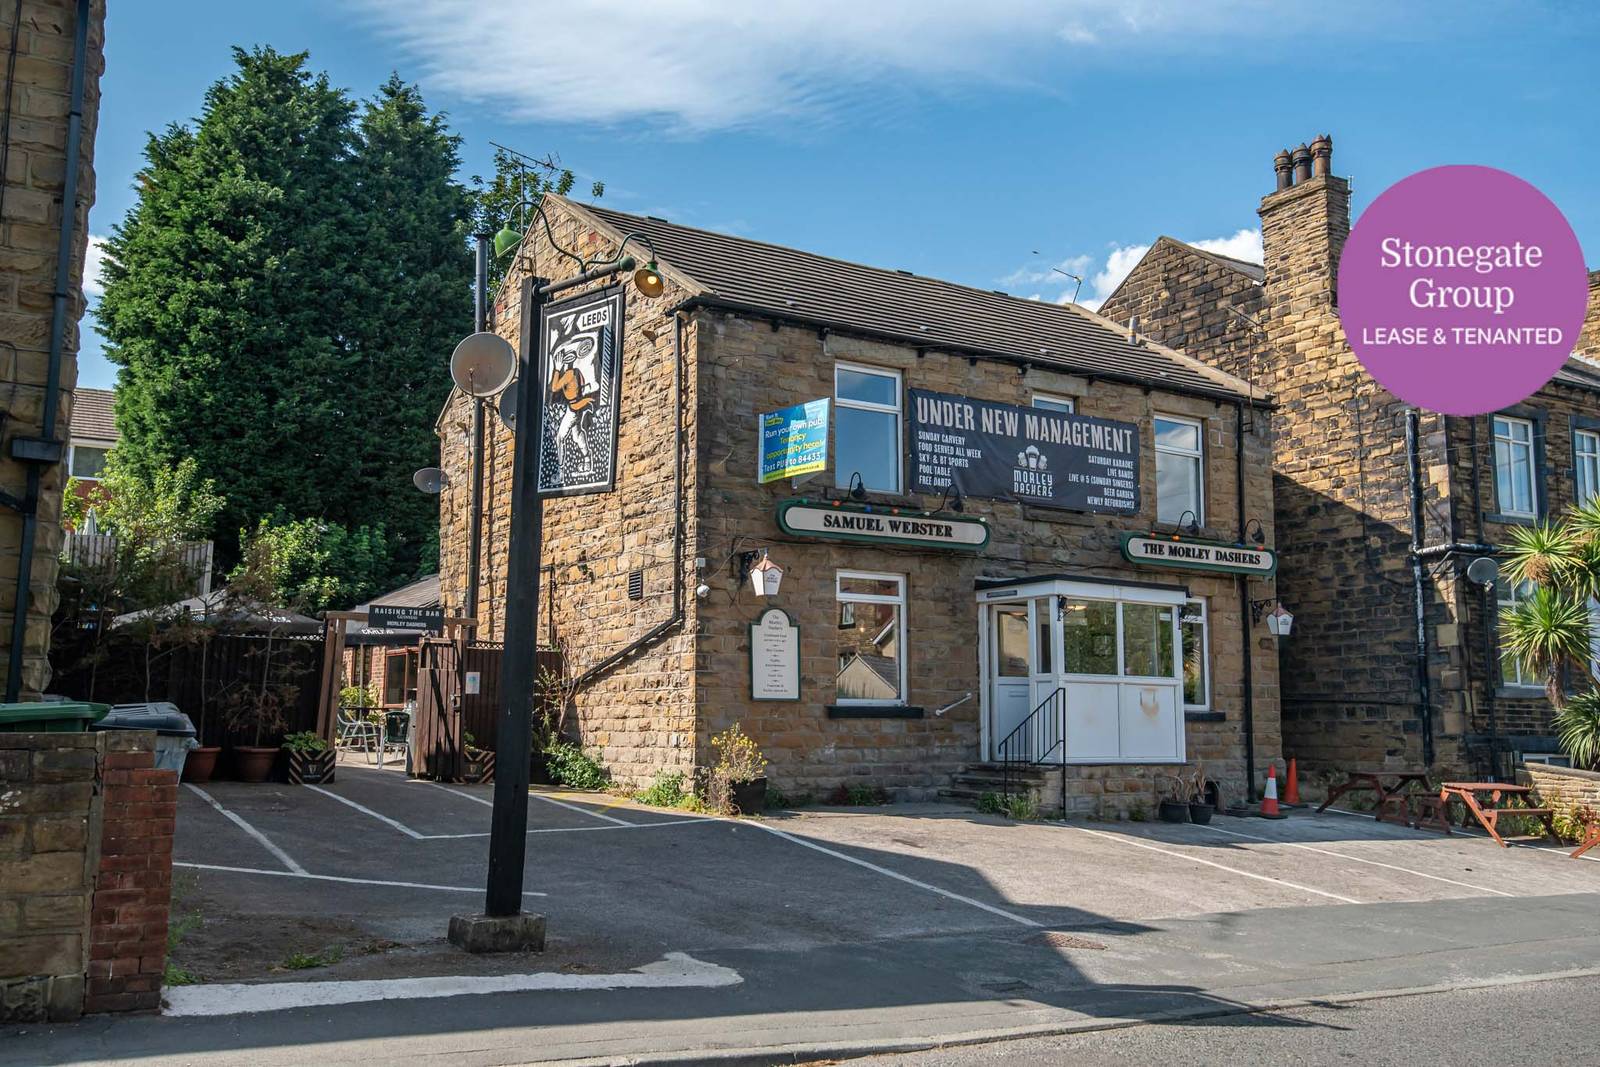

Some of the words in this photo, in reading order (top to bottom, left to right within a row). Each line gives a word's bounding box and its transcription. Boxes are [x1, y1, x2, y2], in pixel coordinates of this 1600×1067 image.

[582, 310, 607, 327] LEEDS
[765, 430, 777, 438] Run
[792, 421, 807, 430] own
[917, 397, 975, 431] UNDER
[981, 407, 1019, 437] NEW
[1025, 414, 1133, 454] MANAGEMENT
[918, 431, 940, 442] SUNDAY
[941, 434, 965, 445] CARVERY
[918, 442, 932, 452] FOOD
[934, 444, 954, 455] SERVED
[955, 447, 965, 456] ALL
[966, 448, 982, 458] WEEK
[919, 453, 930, 463] SKY
[933, 455, 938, 464] &
[940, 456, 947, 465] BT
[948, 457, 969, 468] SPORTS
[1088, 455, 1112, 466] SATURDAY
[1112, 458, 1133, 469] KARAOKE
[919, 464, 933, 474] POOL
[934, 466, 951, 476] TABLE
[1107, 467, 1117, 477] LIVE
[1118, 469, 1133, 479] BANDS
[919, 475, 932, 486] FREE
[933, 477, 951, 487] DARTS
[1013, 470, 1053, 486] MORLEY
[1068, 473, 1079, 482] LIVE
[1085, 475, 1090, 484] 5
[1013, 482, 1053, 497] DASHERS
[1103, 488, 1115, 497] BEER
[1116, 489, 1134, 499] GARDEN
[1087, 496, 1103, 505] NEWLY
[824, 514, 884, 531] SAMUEL
[888, 520, 953, 538] WEBSTER
[1143, 543, 1165, 555] THE
[1168, 545, 1210, 560] MORLEY
[1215, 551, 1260, 565] DASHERS
[375, 607, 406, 615] RAISING
